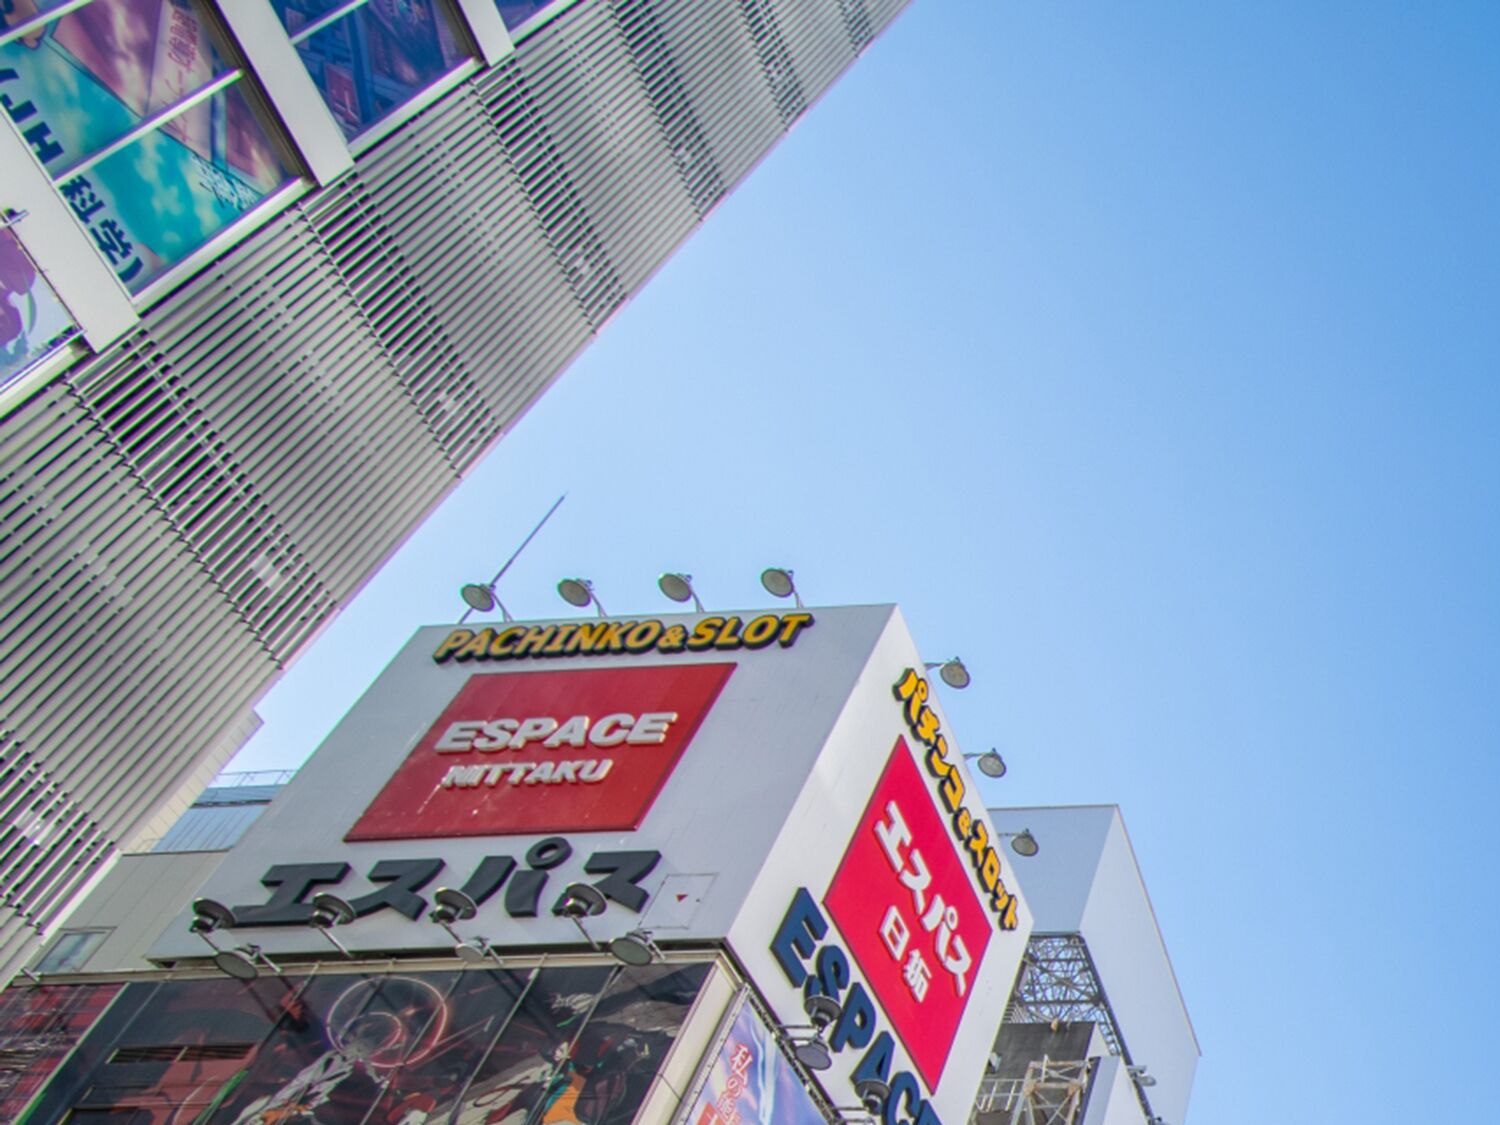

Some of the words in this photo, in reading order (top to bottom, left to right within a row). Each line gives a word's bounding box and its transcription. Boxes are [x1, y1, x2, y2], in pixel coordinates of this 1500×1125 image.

[433, 613, 814, 664] PACHINKO&SLOT
[433, 711, 679, 754] ESPACE
[441, 758, 614, 788] NITTAKU
[230, 836, 663, 928] エスパス
[874, 801, 971, 998] エスパス
